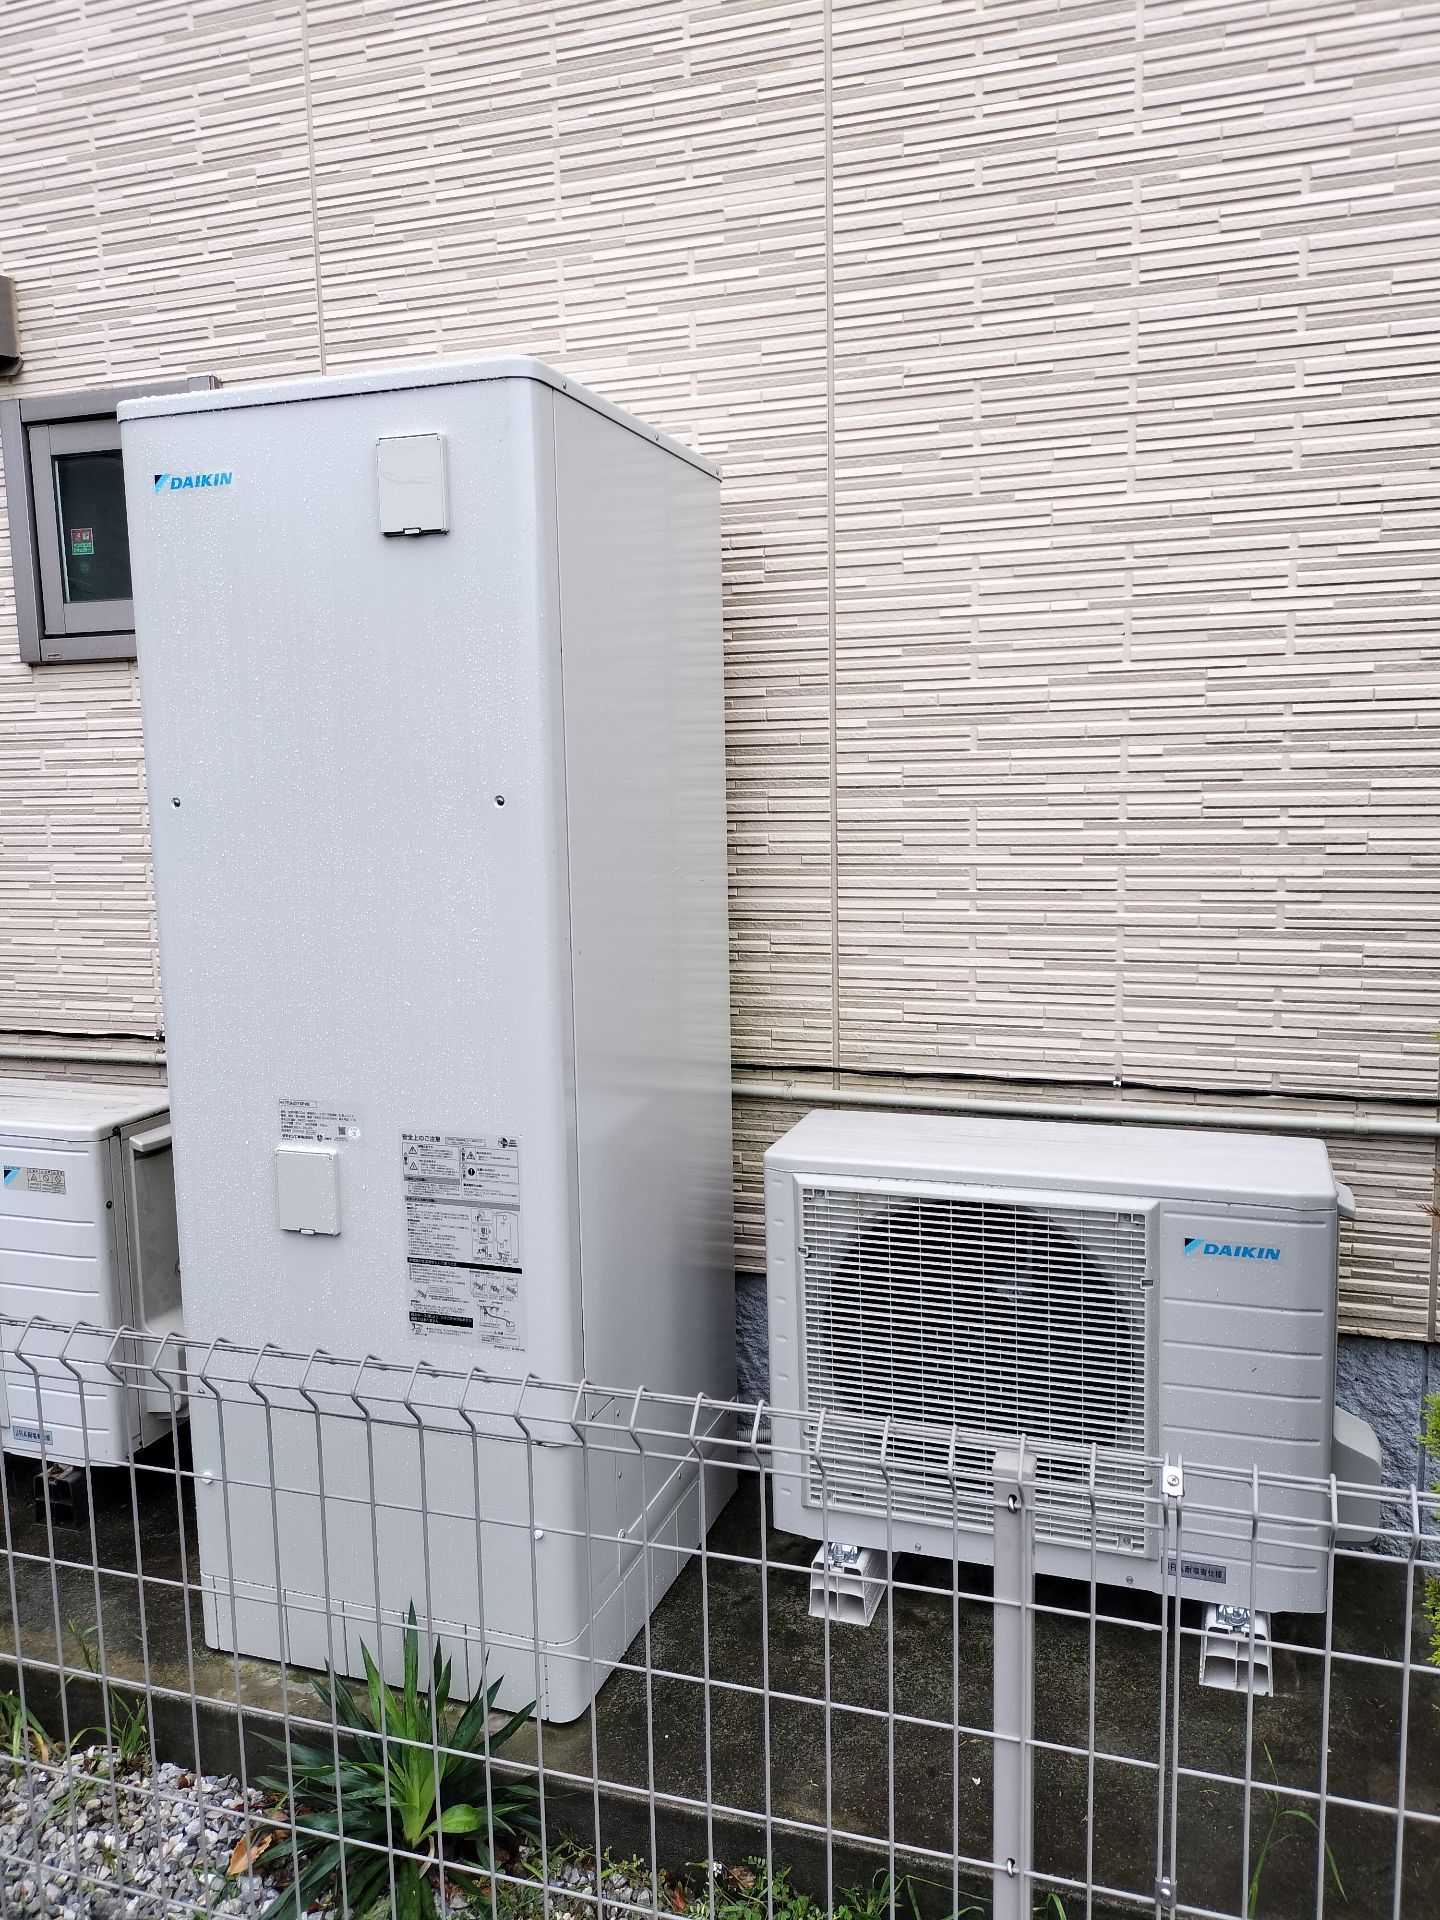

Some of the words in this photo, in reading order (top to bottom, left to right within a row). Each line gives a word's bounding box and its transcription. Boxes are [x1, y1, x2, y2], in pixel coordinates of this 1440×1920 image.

[170, 472, 233, 490] DAIKIN
[402, 1133, 441, 1143] 安全上のご注意
[1203, 1243, 1281, 1260] DAIKIN
